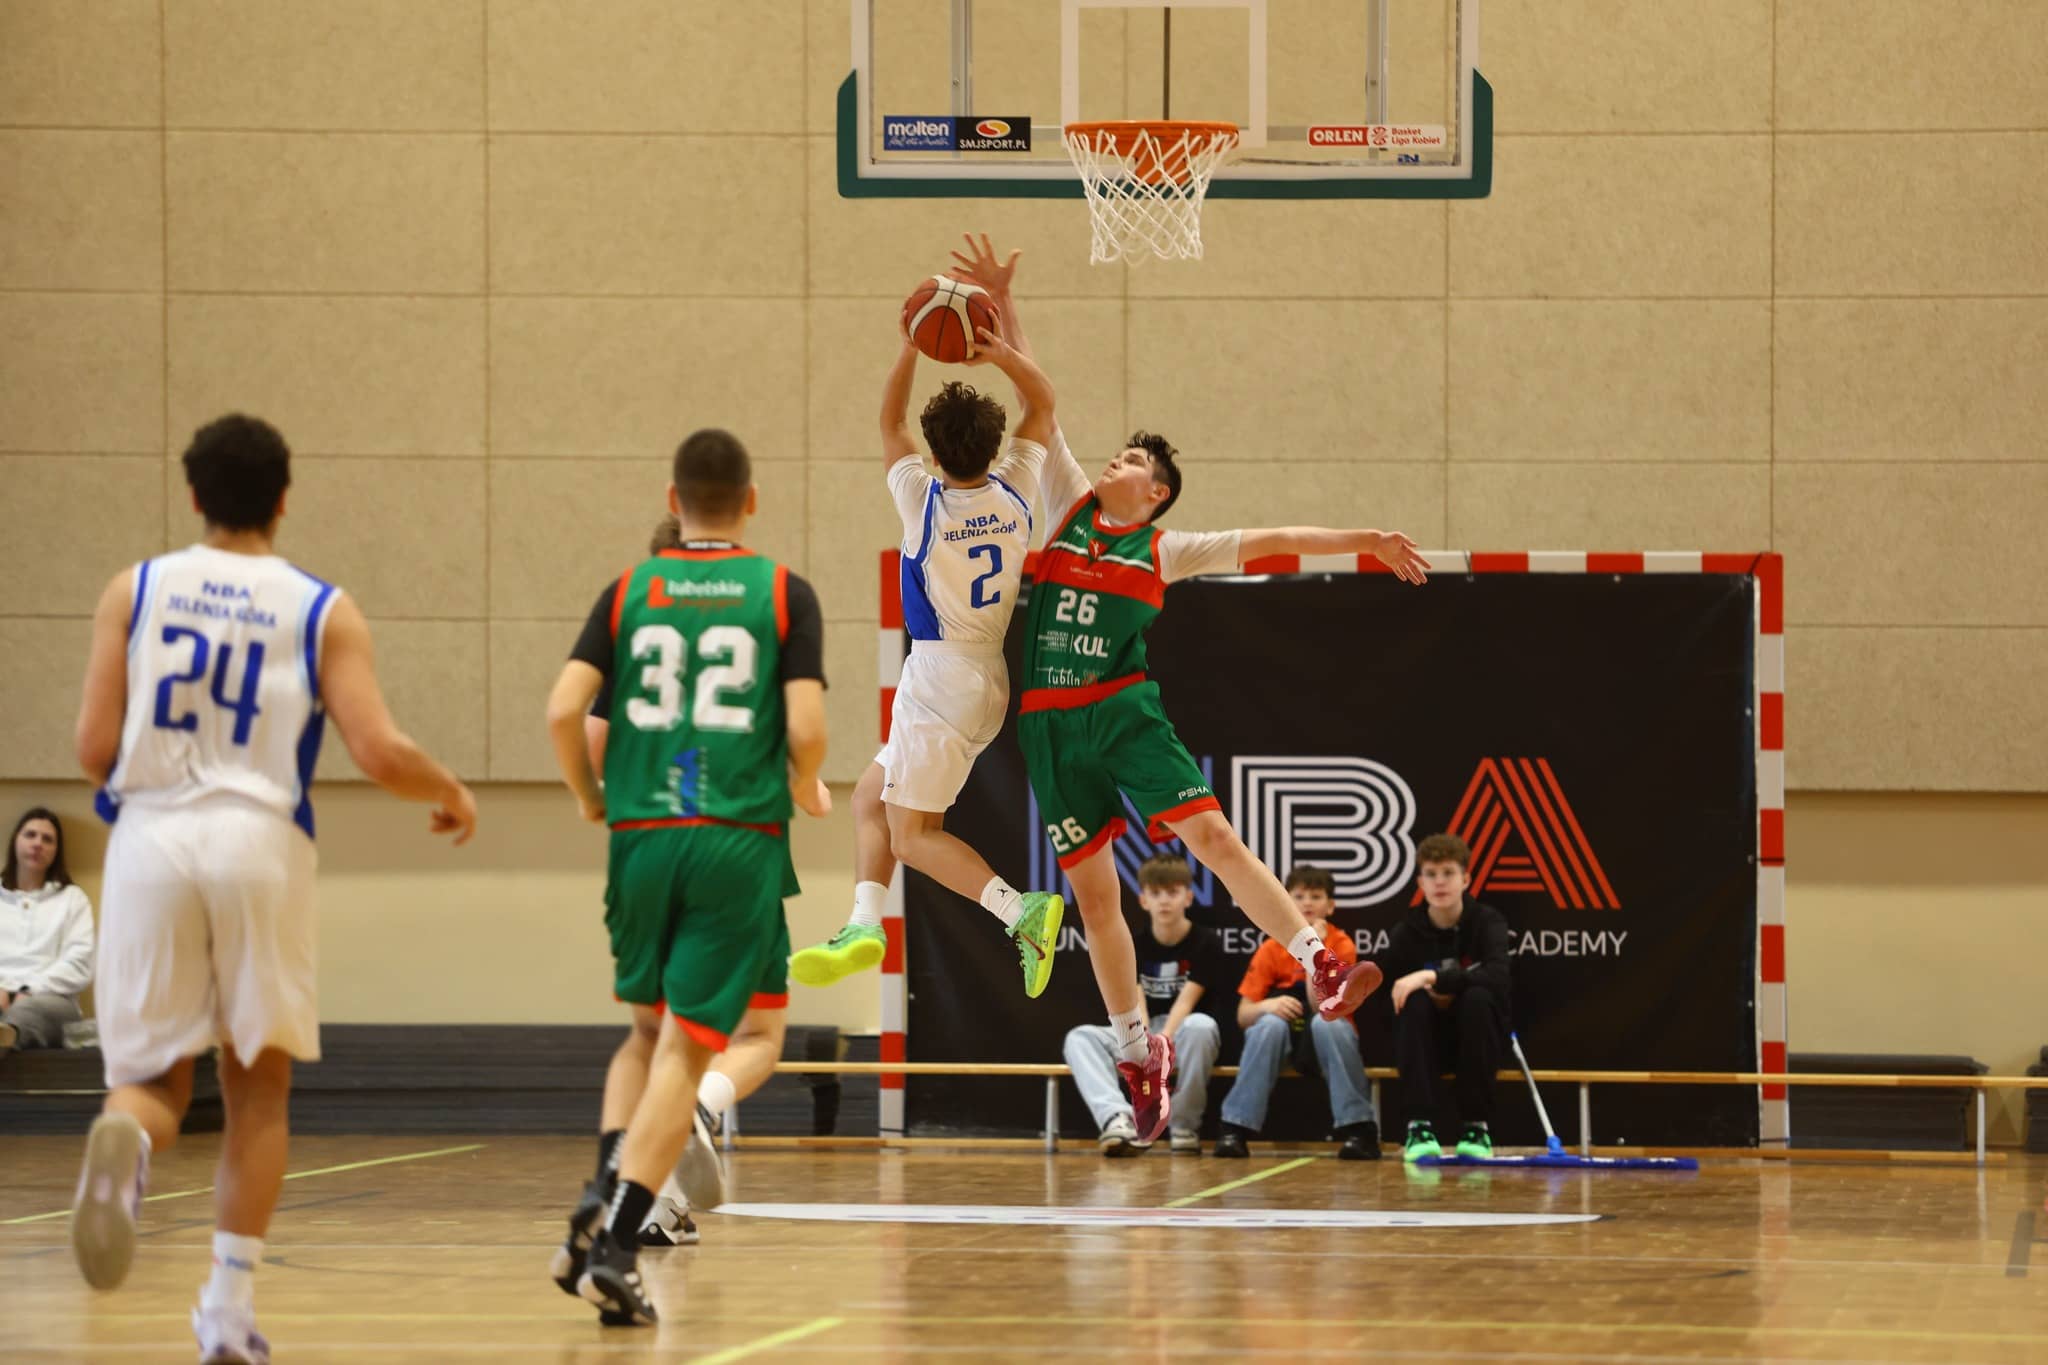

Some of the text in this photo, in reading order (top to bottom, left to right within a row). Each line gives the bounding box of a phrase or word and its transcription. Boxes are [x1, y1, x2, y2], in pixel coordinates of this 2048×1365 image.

[888, 120, 949, 136] molten
[1313, 129, 1363, 143] ORLEN
[1392, 127, 1421, 135] Basket
[960, 139, 1027, 149] SMJSPORT.PL
[965, 513, 999, 528] NBA
[944, 528, 988, 541] JELENIA
[968, 543, 1003, 609] 2
[202, 581, 251, 599] NBA
[1056, 588, 1099, 625] 26
[1073, 634, 1108, 658] KUL
[154, 624, 265, 746] 24
[626, 624, 758, 733] 32
[1048, 665, 1080, 687] lublin
[1047, 817, 1087, 852] 26
